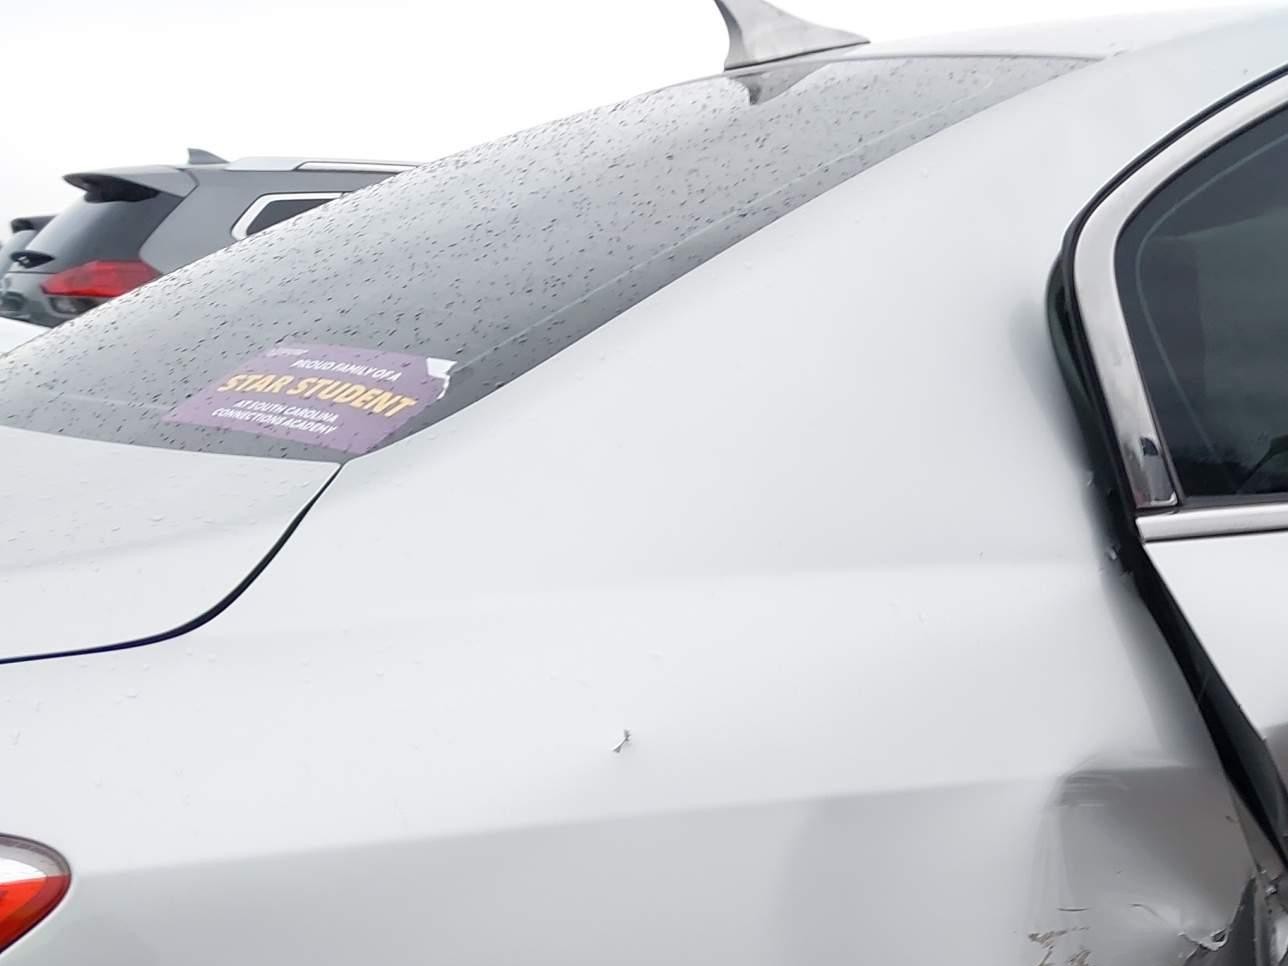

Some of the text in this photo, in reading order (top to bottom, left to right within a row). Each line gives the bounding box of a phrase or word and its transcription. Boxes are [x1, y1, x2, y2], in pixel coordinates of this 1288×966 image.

[290, 359, 402, 382] PROUD FAMILY OF A
[217, 374, 417, 417] STAR STUDENT
[211, 407, 338, 434] CONNECTIONS ACADEMY
[232, 400, 340, 423] AT SOUTH CAROLINA
